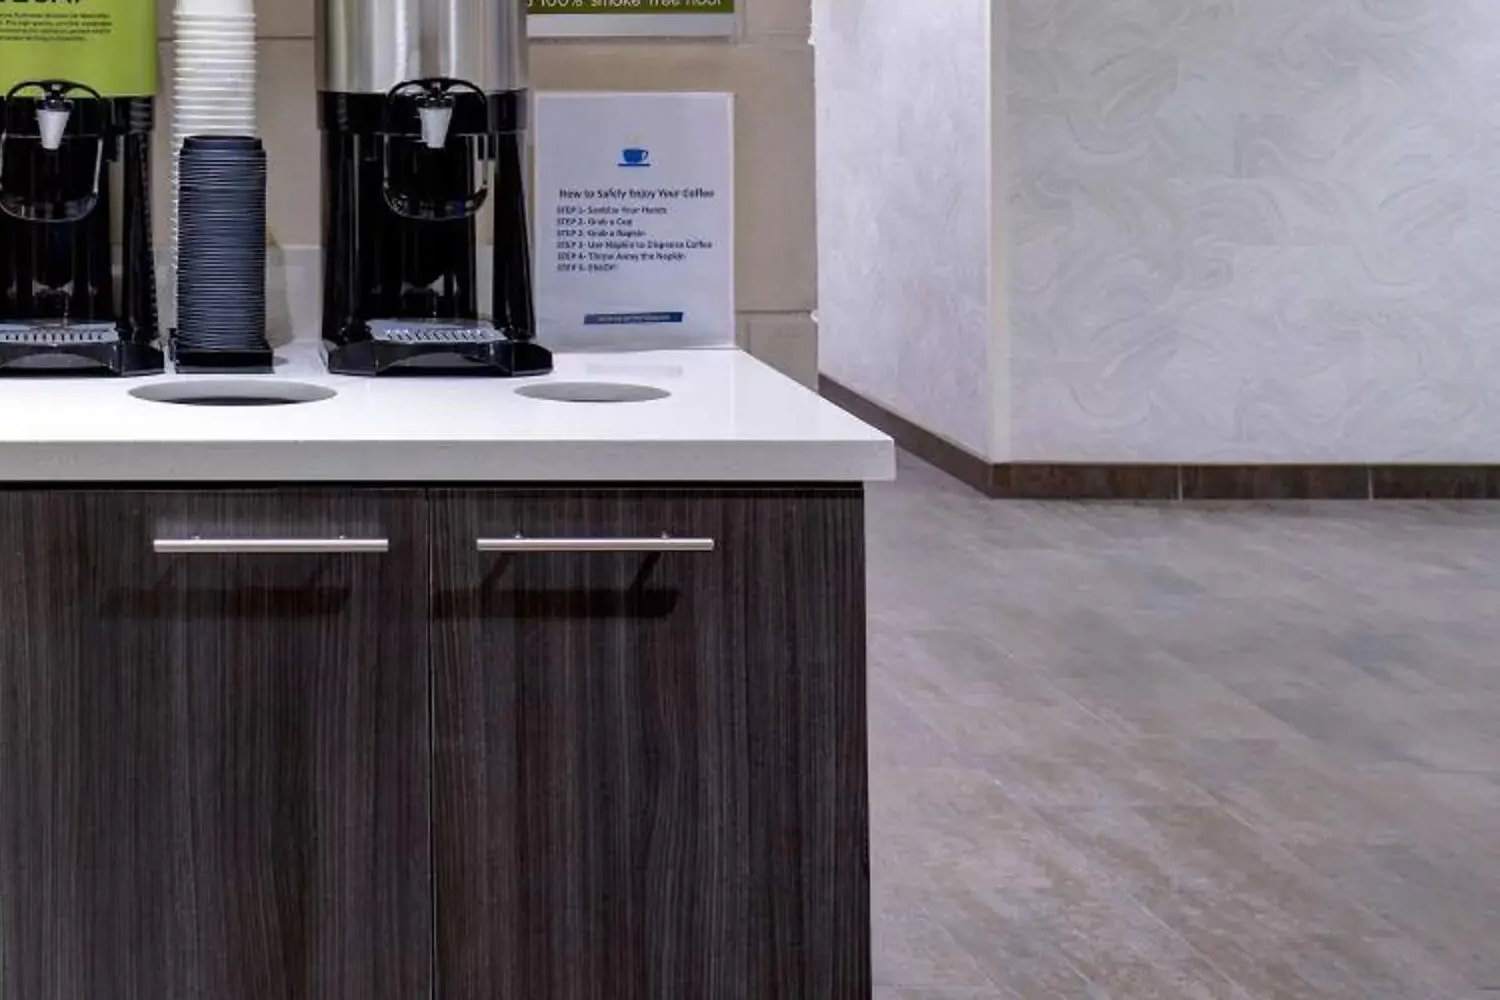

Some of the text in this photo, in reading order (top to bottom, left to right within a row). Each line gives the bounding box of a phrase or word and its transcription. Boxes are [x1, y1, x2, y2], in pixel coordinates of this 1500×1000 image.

[559, 188, 580, 199] How
[585, 188, 595, 199] to
[597, 188, 627, 200] Safely
[683, 188, 714, 199] Coffee
